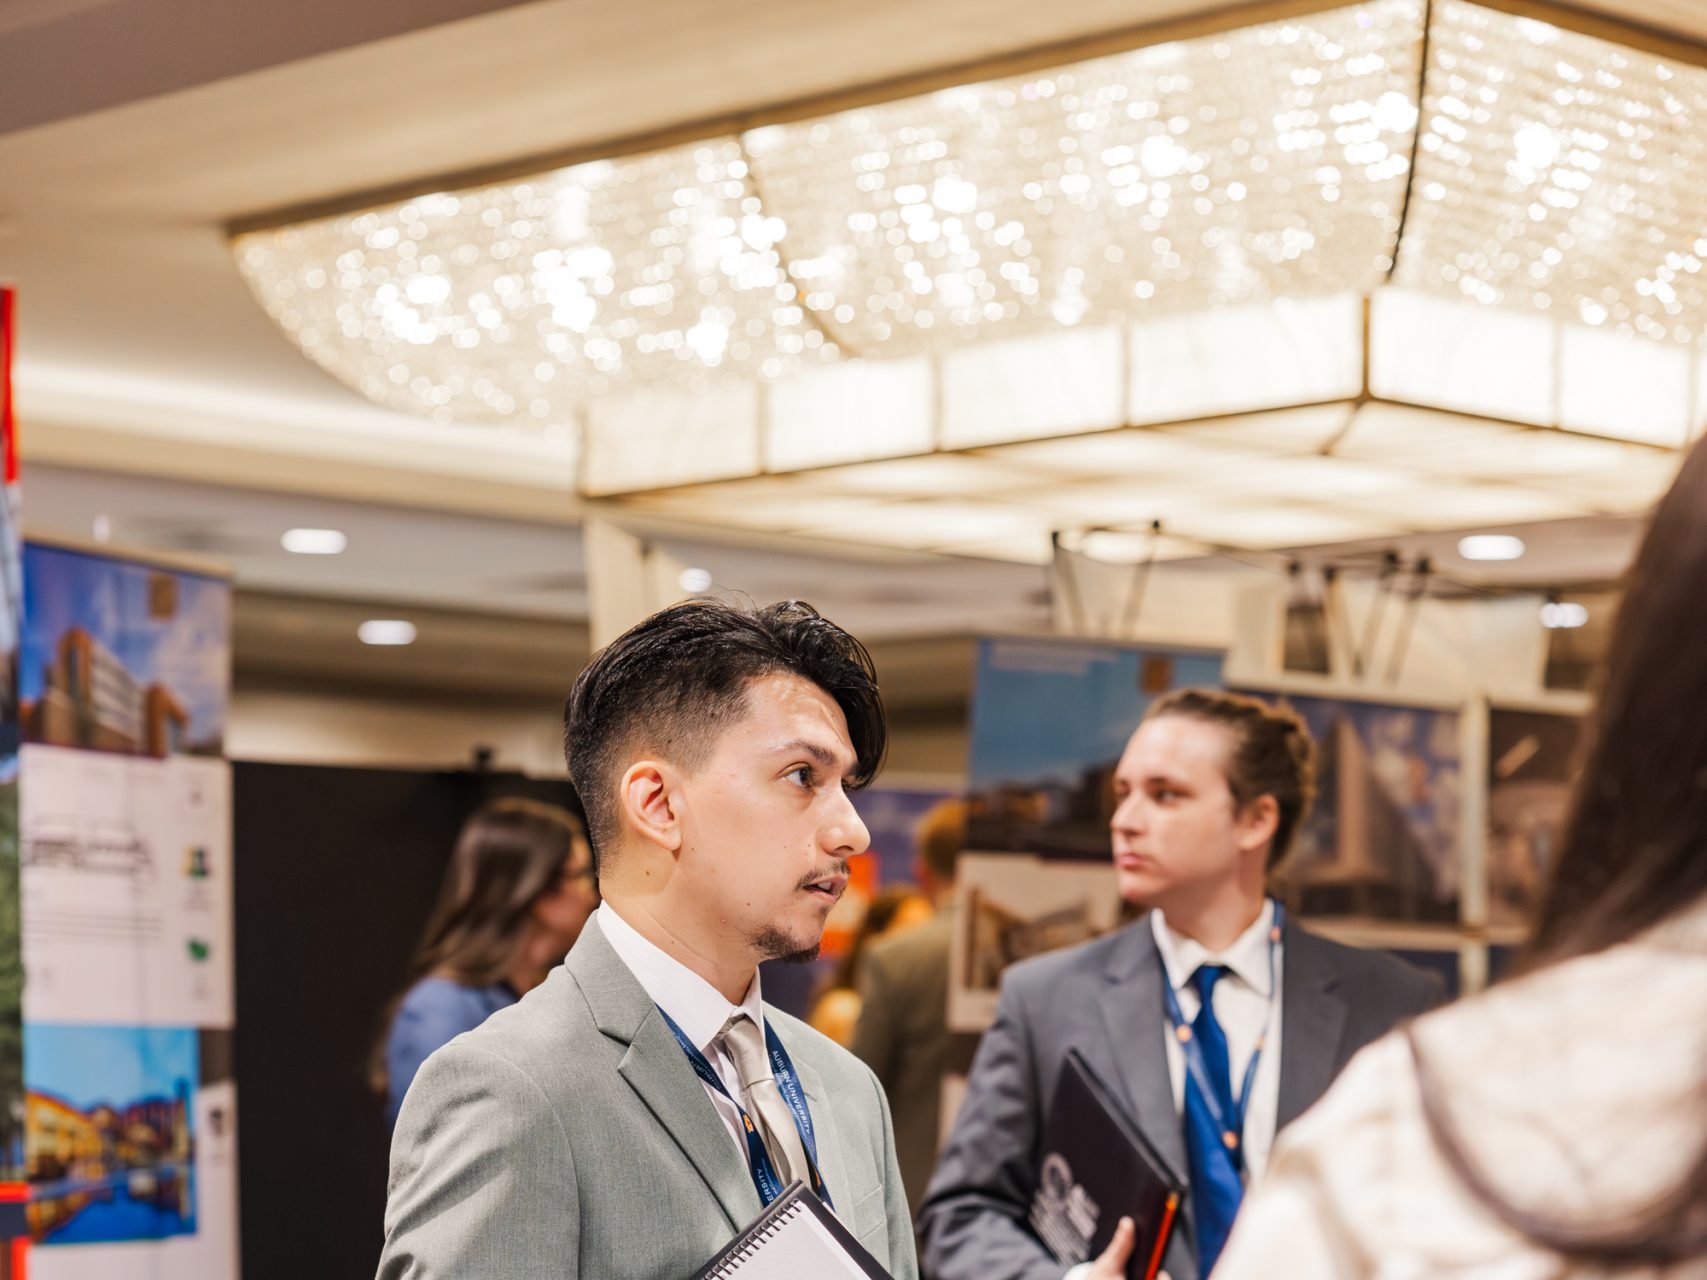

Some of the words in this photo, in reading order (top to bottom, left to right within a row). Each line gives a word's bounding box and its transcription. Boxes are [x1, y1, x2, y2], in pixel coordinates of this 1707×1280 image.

[772, 1050, 791, 1083] AUBURN
[787, 1083, 811, 1135] UNIVERSITY
[756, 1168, 774, 1203] ERSITY
